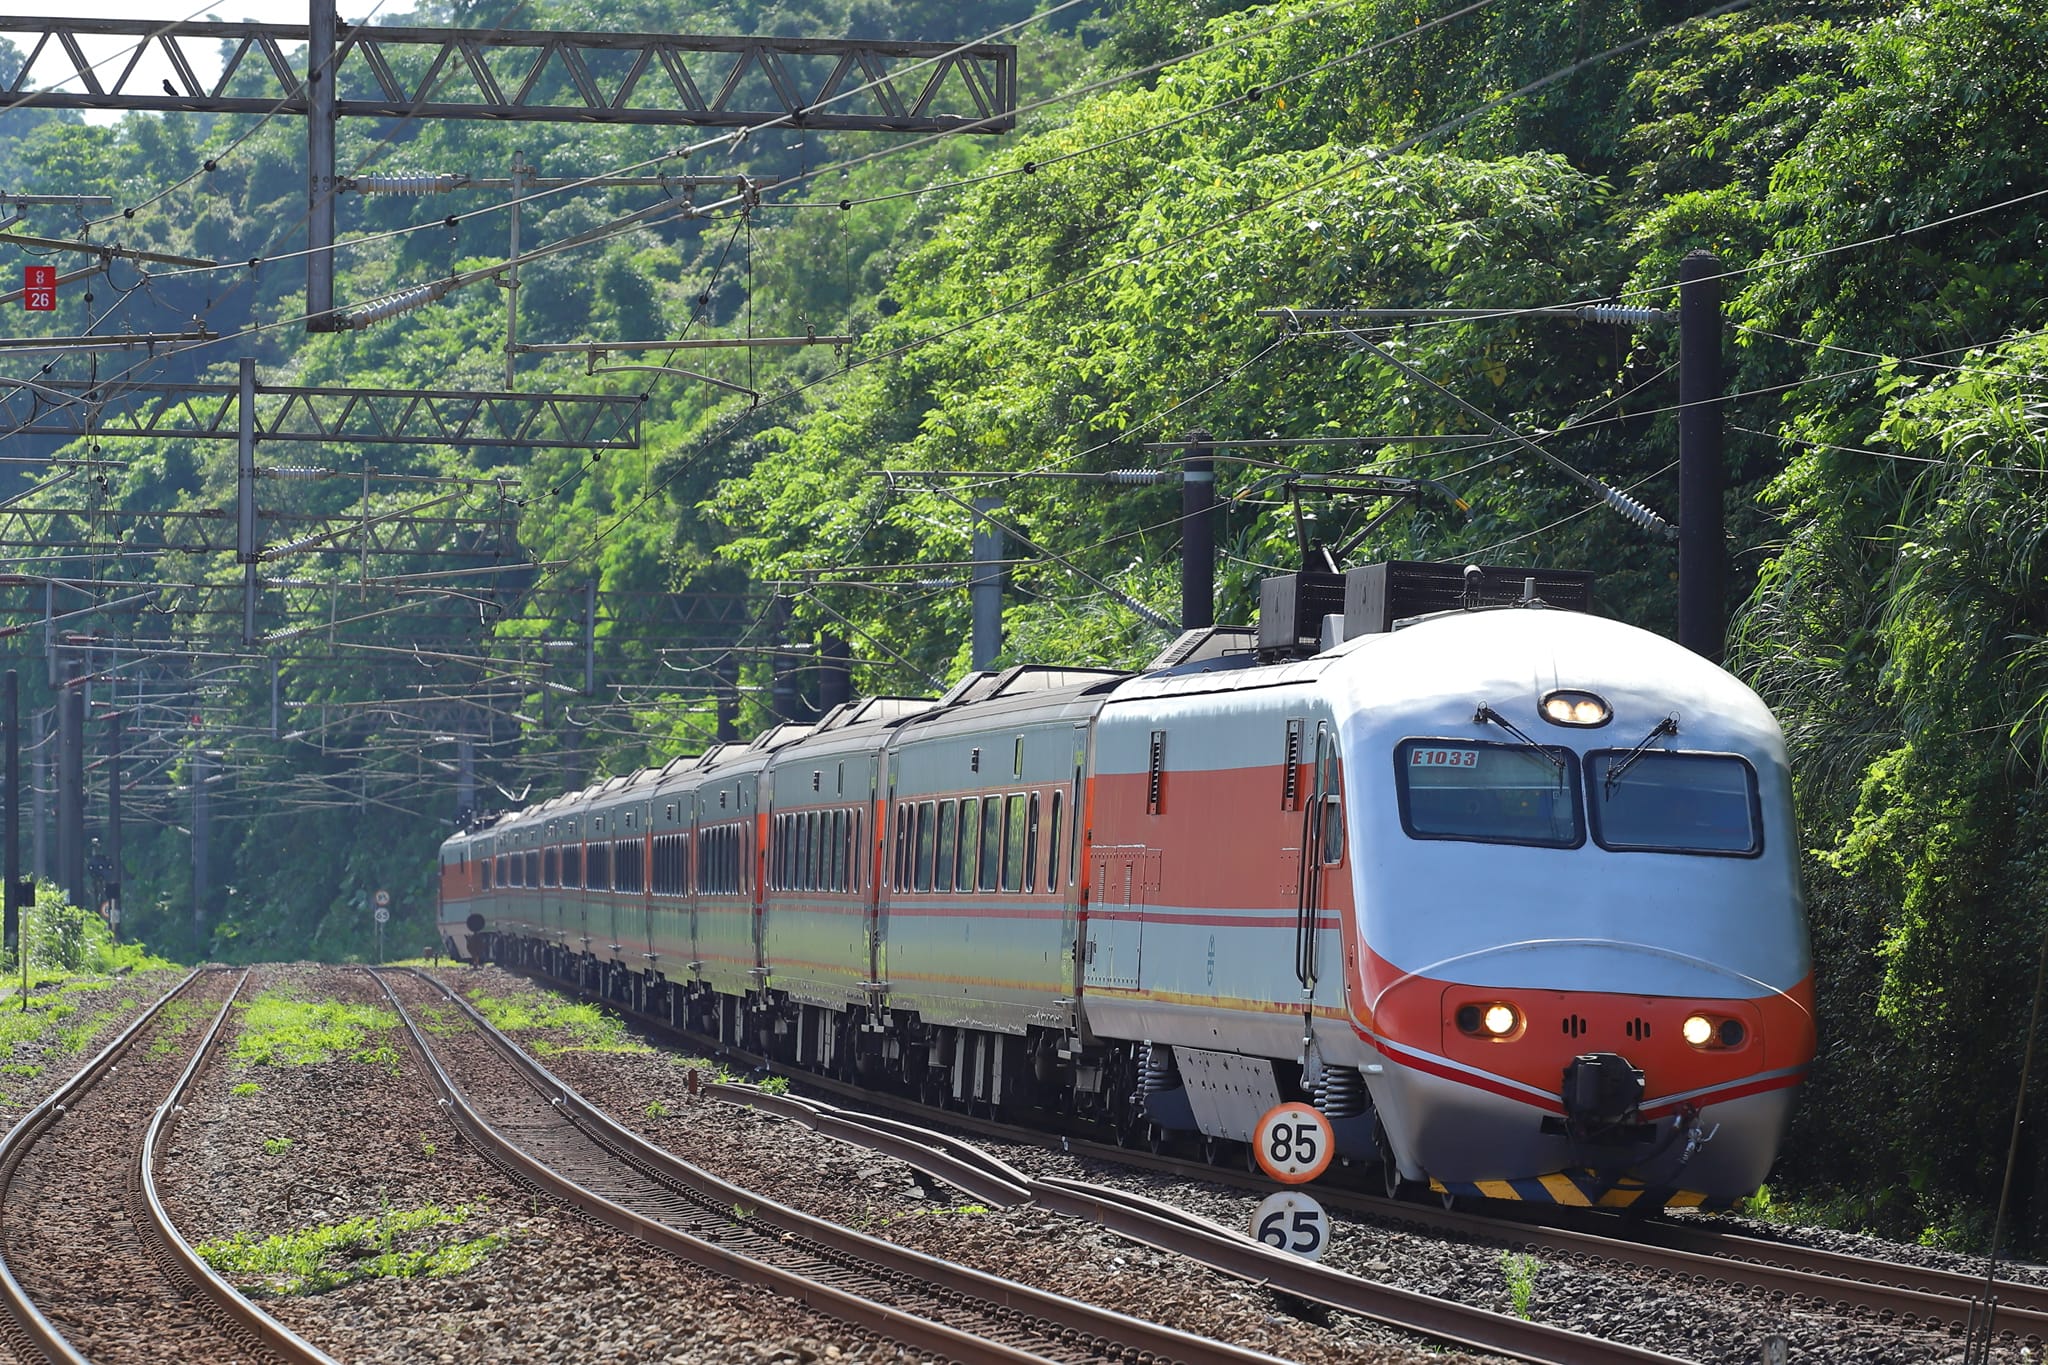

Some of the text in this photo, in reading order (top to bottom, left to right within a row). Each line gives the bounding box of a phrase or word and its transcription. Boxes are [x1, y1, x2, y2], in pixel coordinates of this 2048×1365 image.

[36, 270, 45, 284] 8
[31, 293, 49, 307] 26
[1412, 750, 1476, 766] E1033
[1270, 1123, 1317, 1164] 85
[1258, 1211, 1320, 1253] 65
